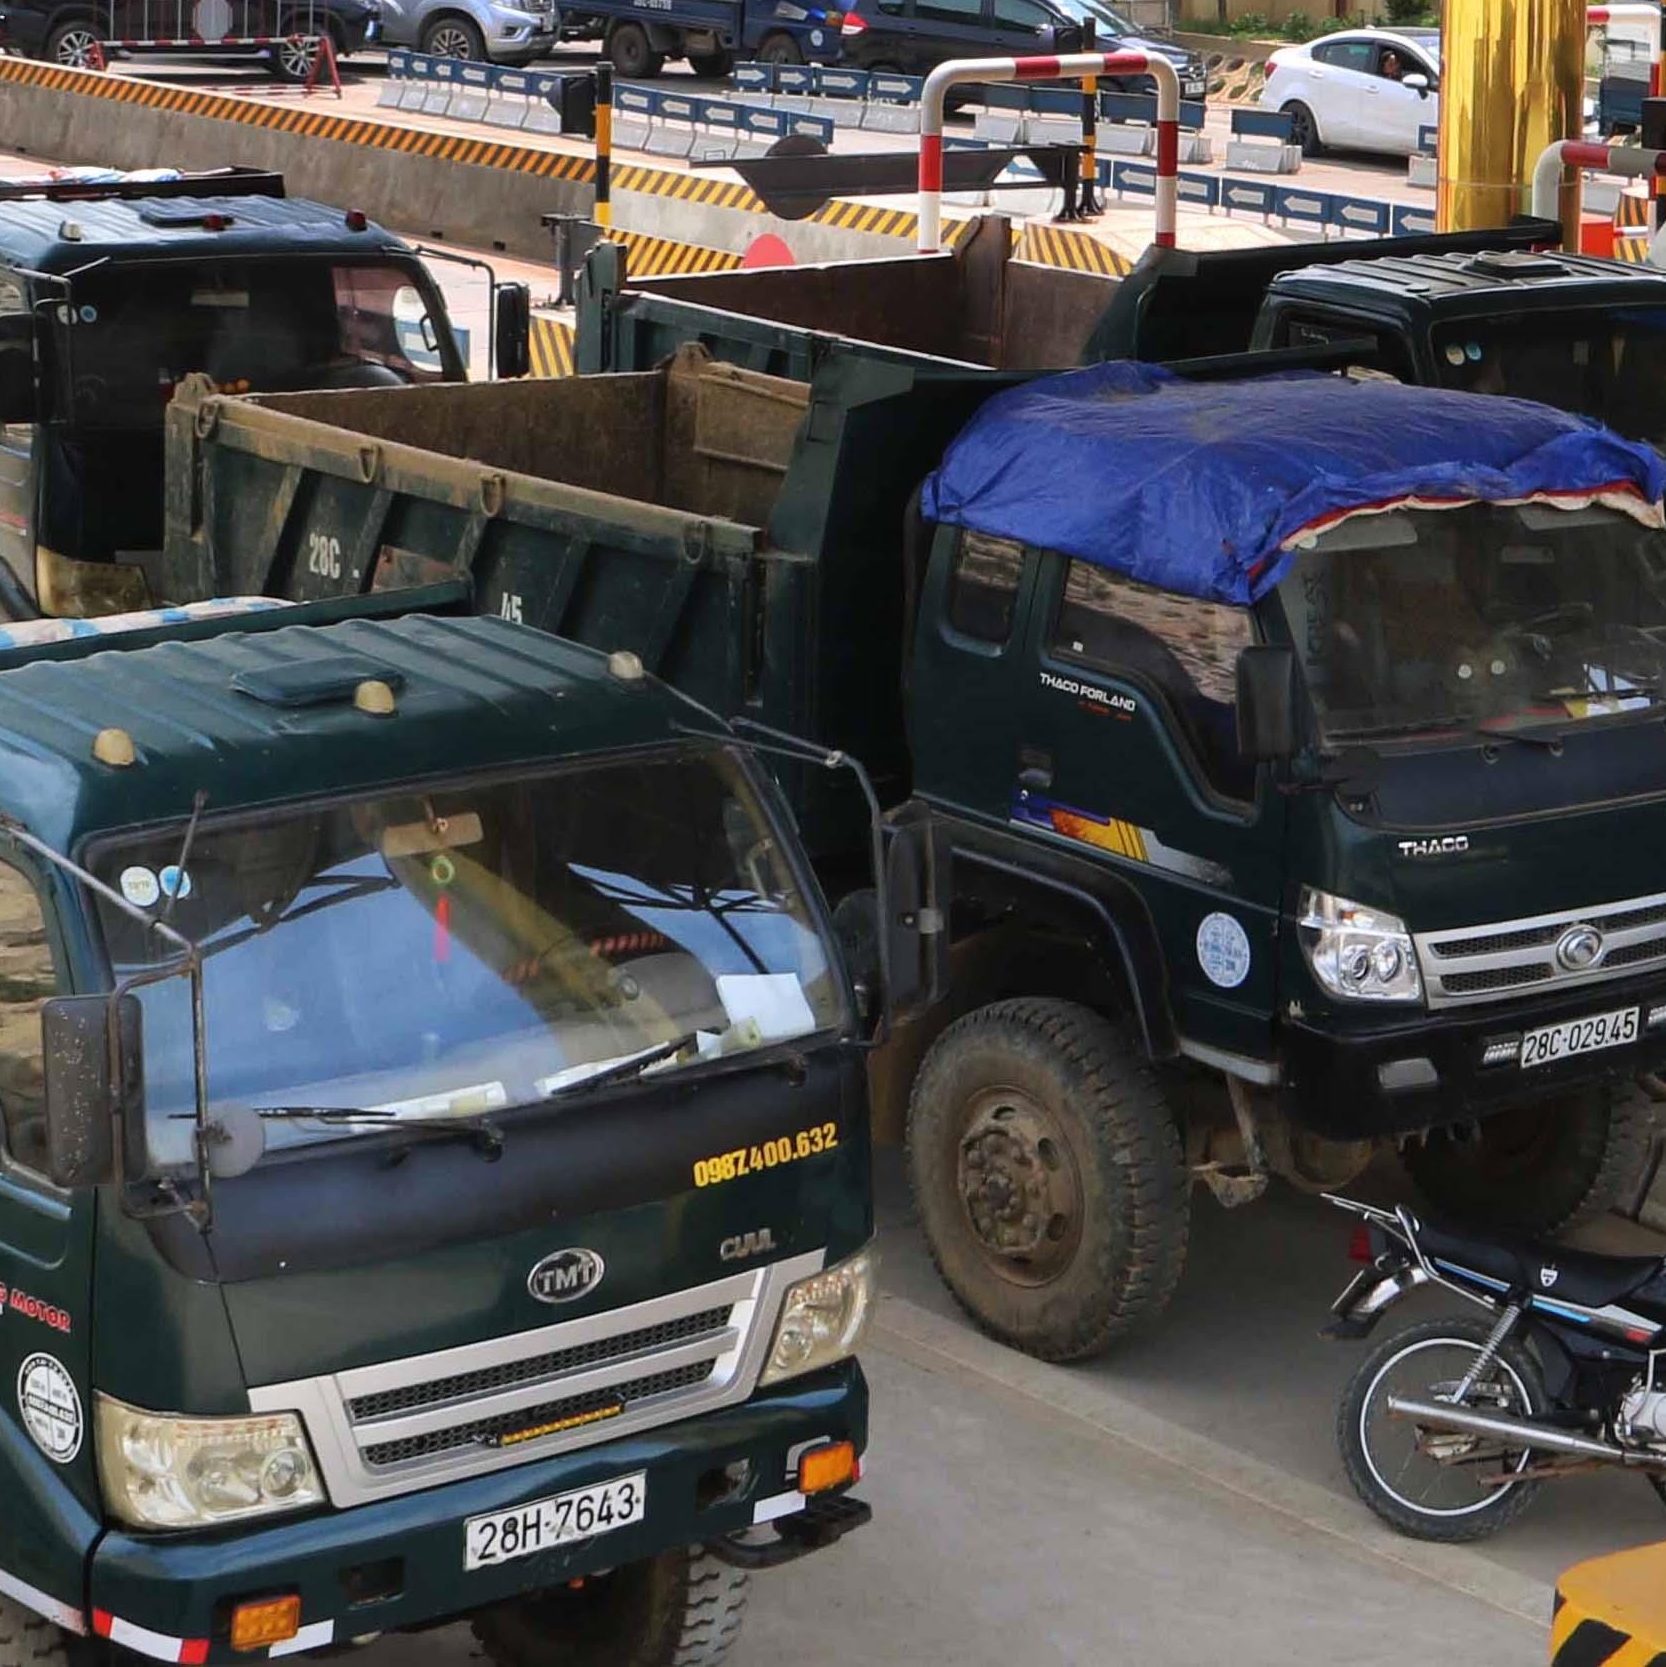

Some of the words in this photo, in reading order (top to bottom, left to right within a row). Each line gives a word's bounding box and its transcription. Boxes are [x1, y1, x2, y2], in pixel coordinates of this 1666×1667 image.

[309, 532, 341, 579] 28C
[1040, 672, 1079, 694] THACO
[1080, 685, 1136, 712] FORLAND
[1398, 836, 1469, 857] THACO
[539, 1260, 595, 1294] TMT
[10, 1288, 71, 1333] MOTOR
